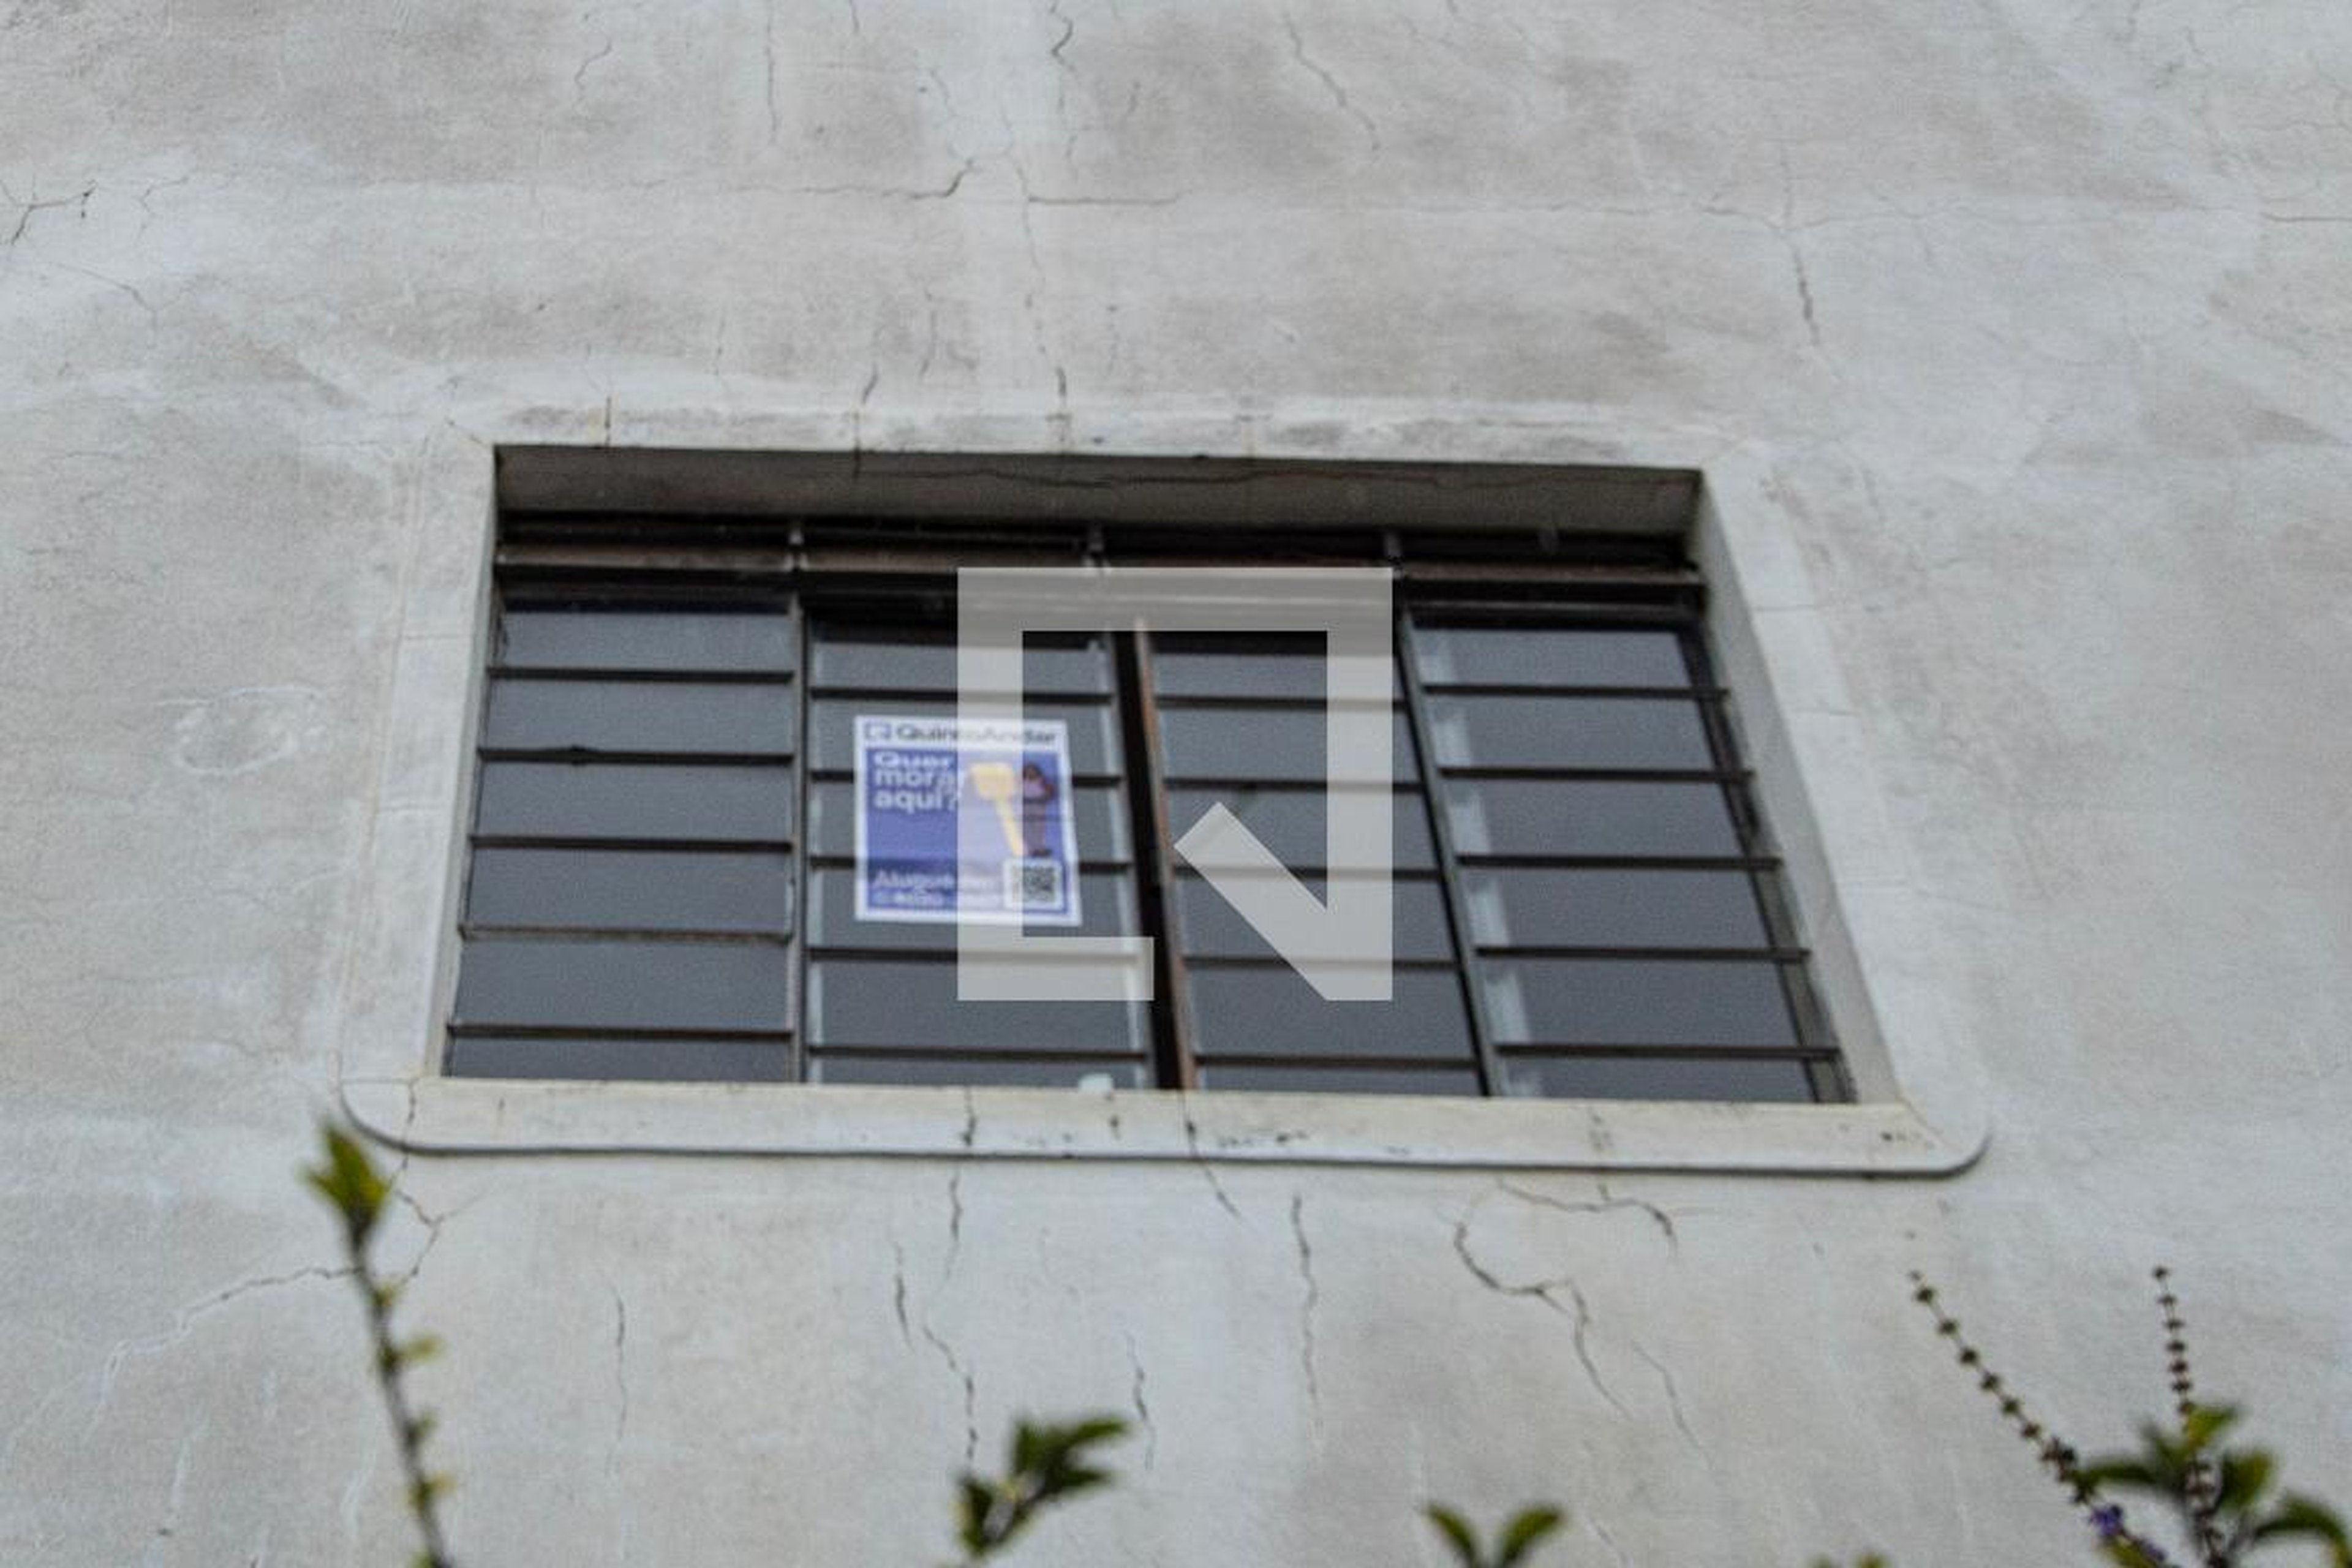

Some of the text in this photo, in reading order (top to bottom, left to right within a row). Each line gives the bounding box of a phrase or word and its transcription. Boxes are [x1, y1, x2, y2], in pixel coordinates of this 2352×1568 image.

[874, 752, 954, 768] Quer
[875, 768, 964, 788] morar
[875, 785, 962, 814] aqui?
